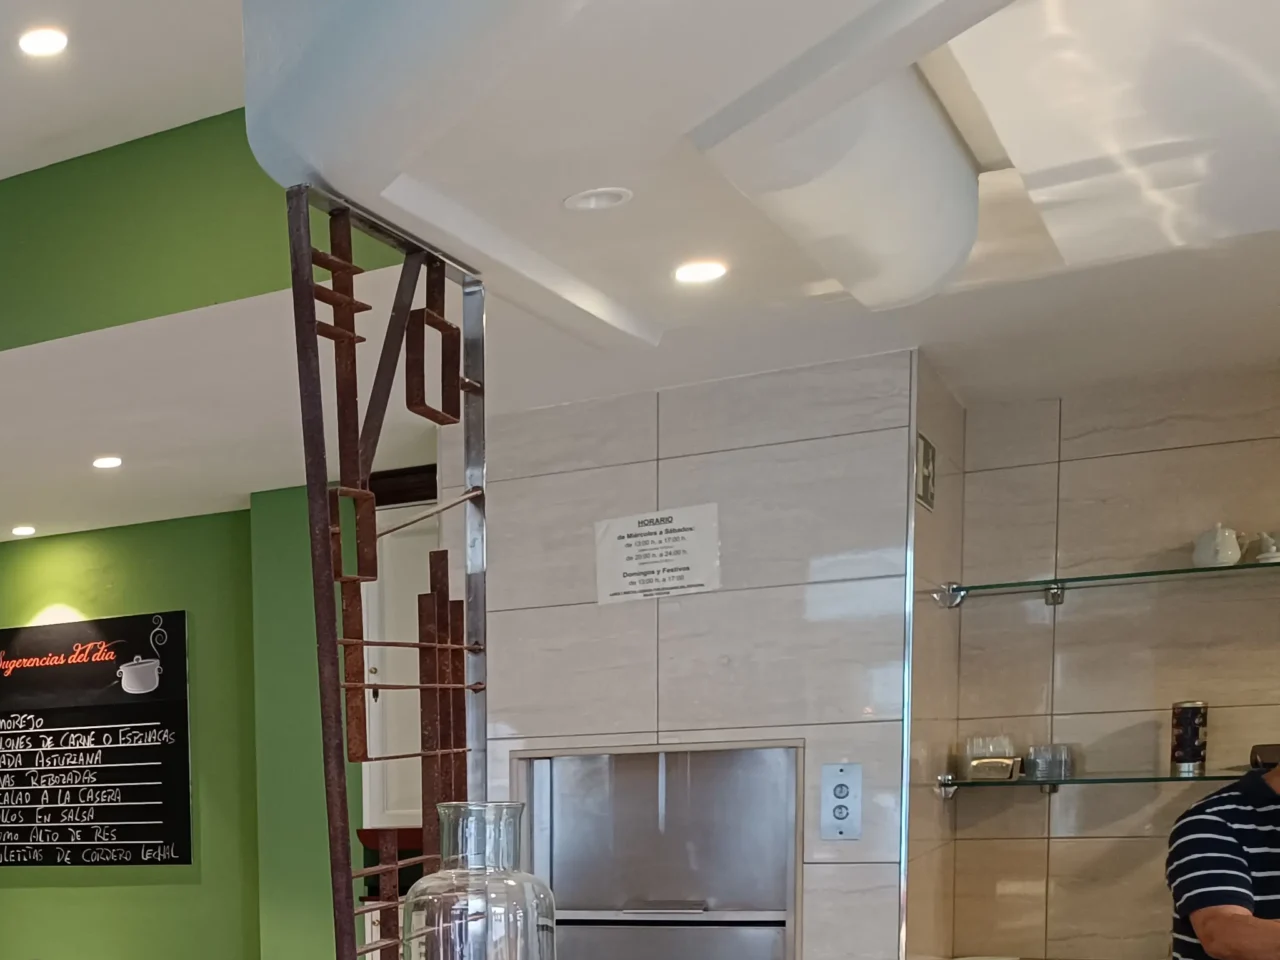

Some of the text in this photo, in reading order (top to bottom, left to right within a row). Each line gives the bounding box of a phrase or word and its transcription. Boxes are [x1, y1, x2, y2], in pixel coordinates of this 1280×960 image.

[637, 516, 674, 528] HORARIO
[627, 531, 657, 539] Miércoles
[623, 569, 655, 578] Domingos
[662, 565, 690, 573] Festivos
[67, 642, 90, 664] del
[39, 735, 55, 749] DE
[60, 731, 96, 748] CARNE
[103, 733, 112, 746] O
[119, 727, 176, 746] ESPINACAS
[35, 749, 102, 768] ASTURIANA
[25, 769, 97, 787] REBOZADAS
[41, 790, 49, 805] A
[58, 789, 71, 805] LA
[79, 788, 121, 804] CASERA
[36, 807, 51, 823] EN
[60, 807, 94, 822] SALSA
[29, 826, 59, 842] ALTO
[68, 828, 82, 841] DE
[91, 826, 117, 841] RES
[56, 847, 71, 864] DE
[81, 848, 132, 863] CORDERO
[141, 842, 180, 861] LECHAL
